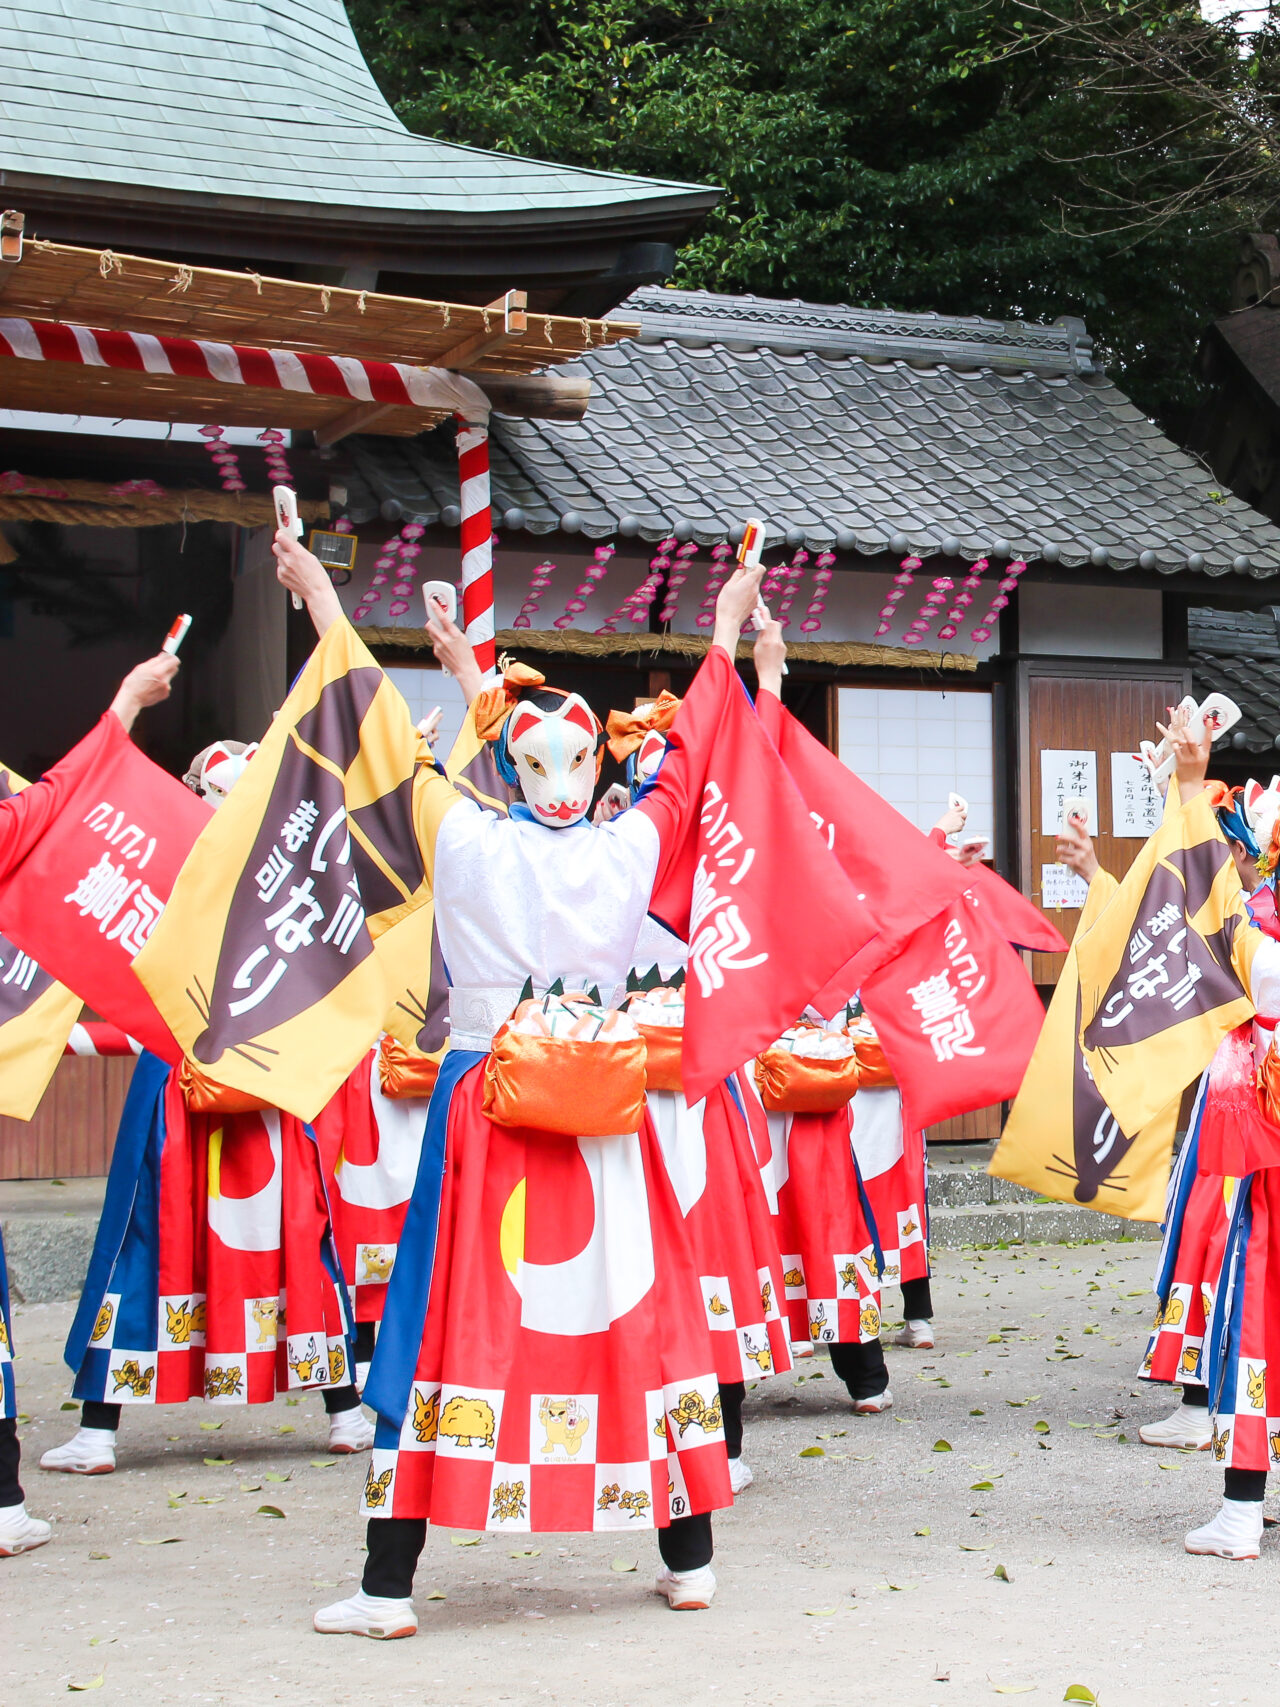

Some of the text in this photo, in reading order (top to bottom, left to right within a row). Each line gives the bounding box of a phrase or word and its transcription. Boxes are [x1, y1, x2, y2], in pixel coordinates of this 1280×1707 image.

[1068, 760, 1089, 797] 御朱印
[83, 802, 157, 869] コンコン
[254, 799, 320, 904] 寿司
[700, 781, 756, 885] コンコン
[944, 919, 986, 999] コンコン
[1129, 902, 1183, 964] 寿司
